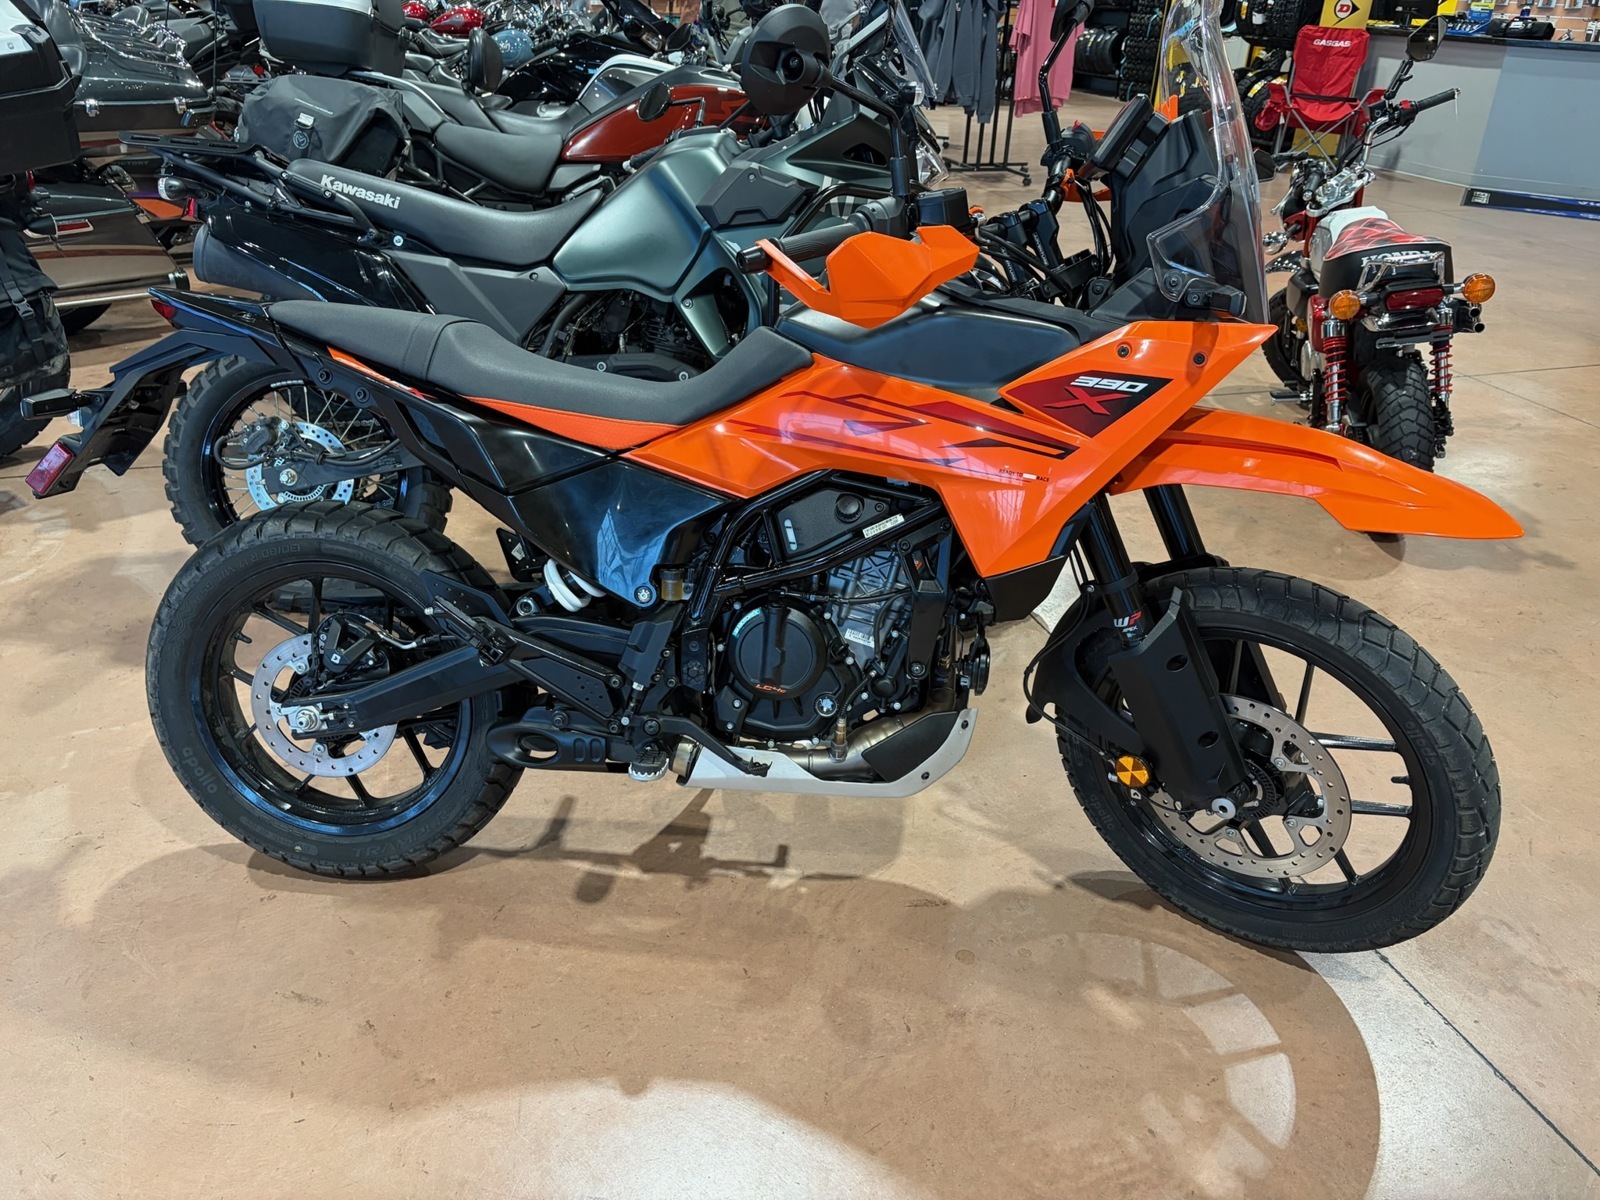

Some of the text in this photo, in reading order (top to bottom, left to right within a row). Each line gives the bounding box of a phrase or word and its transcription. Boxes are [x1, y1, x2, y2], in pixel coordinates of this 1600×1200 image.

[1337, 4, 1351, 13] D
[1313, 38, 1352, 48] GASGAS
[320, 174, 401, 209] Kawasaki
[1070, 375, 1149, 393] 390
[1043, 386, 1132, 416] X
[999, 468, 1016, 476] READY
[1113, 611, 1142, 628] WP
[182, 747, 218, 794] apollo
[1090, 794, 1114, 830] apollo
